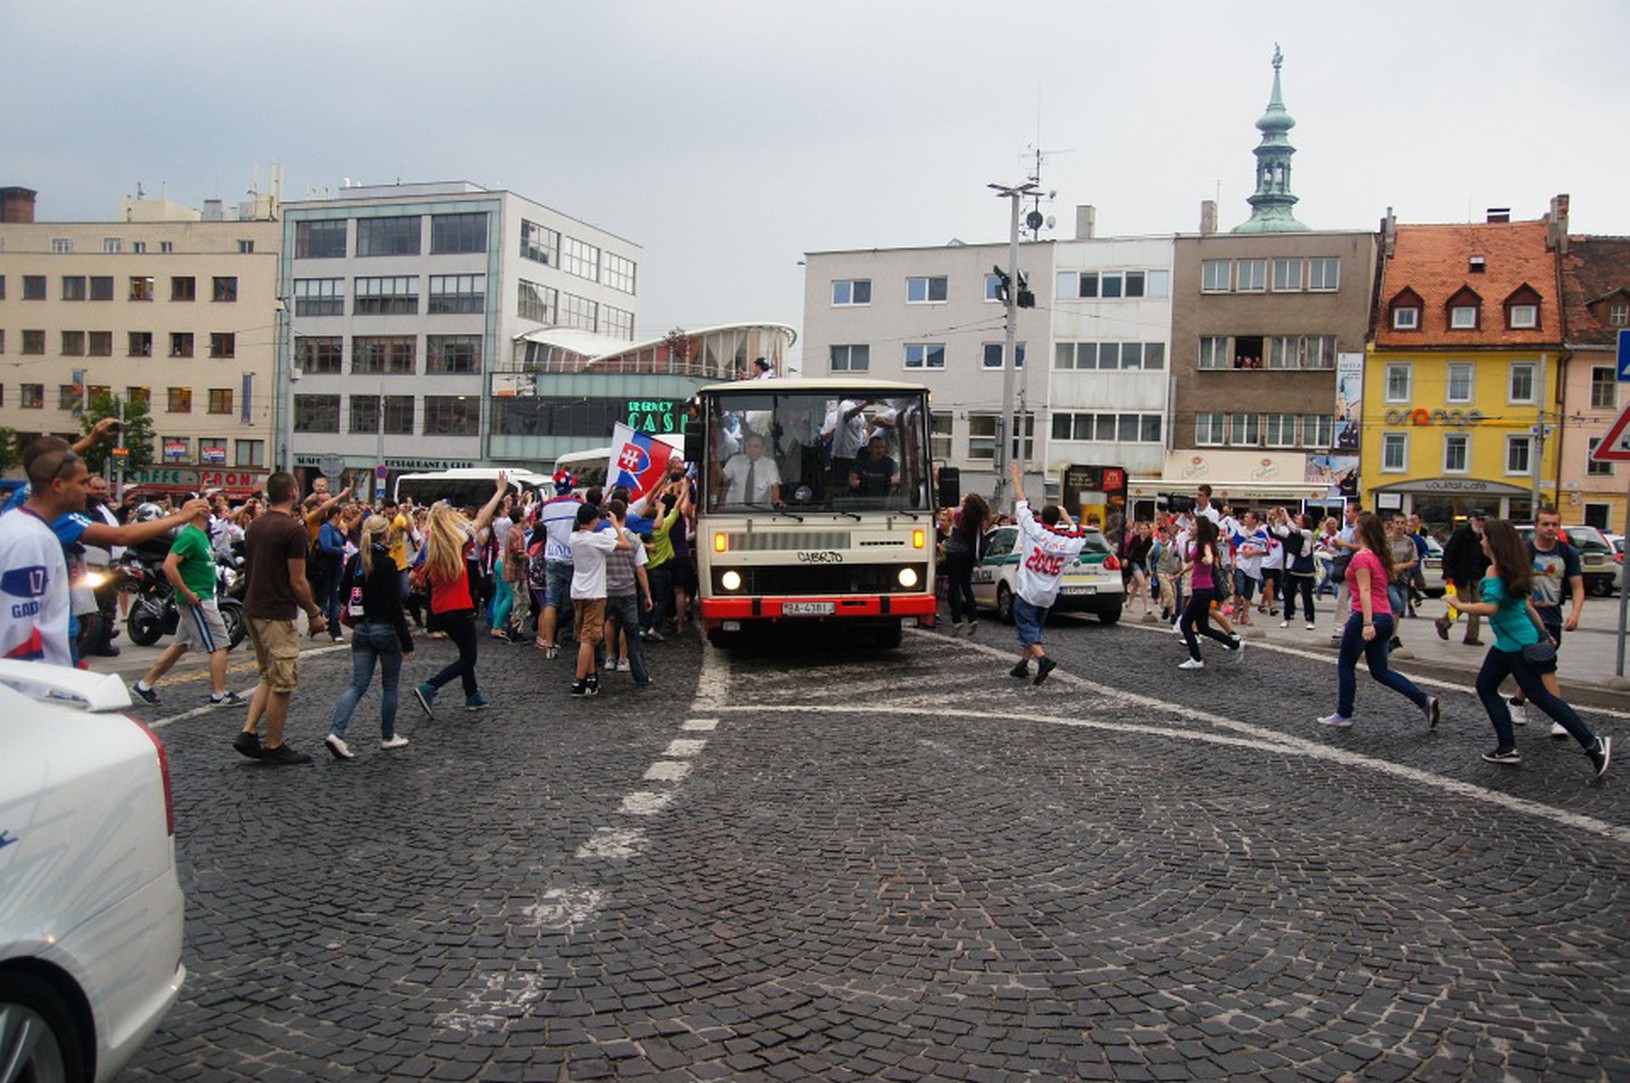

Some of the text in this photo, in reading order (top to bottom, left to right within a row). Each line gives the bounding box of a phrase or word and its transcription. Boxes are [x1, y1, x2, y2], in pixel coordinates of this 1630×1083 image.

[1385, 408, 1483, 431] orange
[385, 459, 440, 468] RESTAURANT
[1025, 546, 1066, 577] 2006
